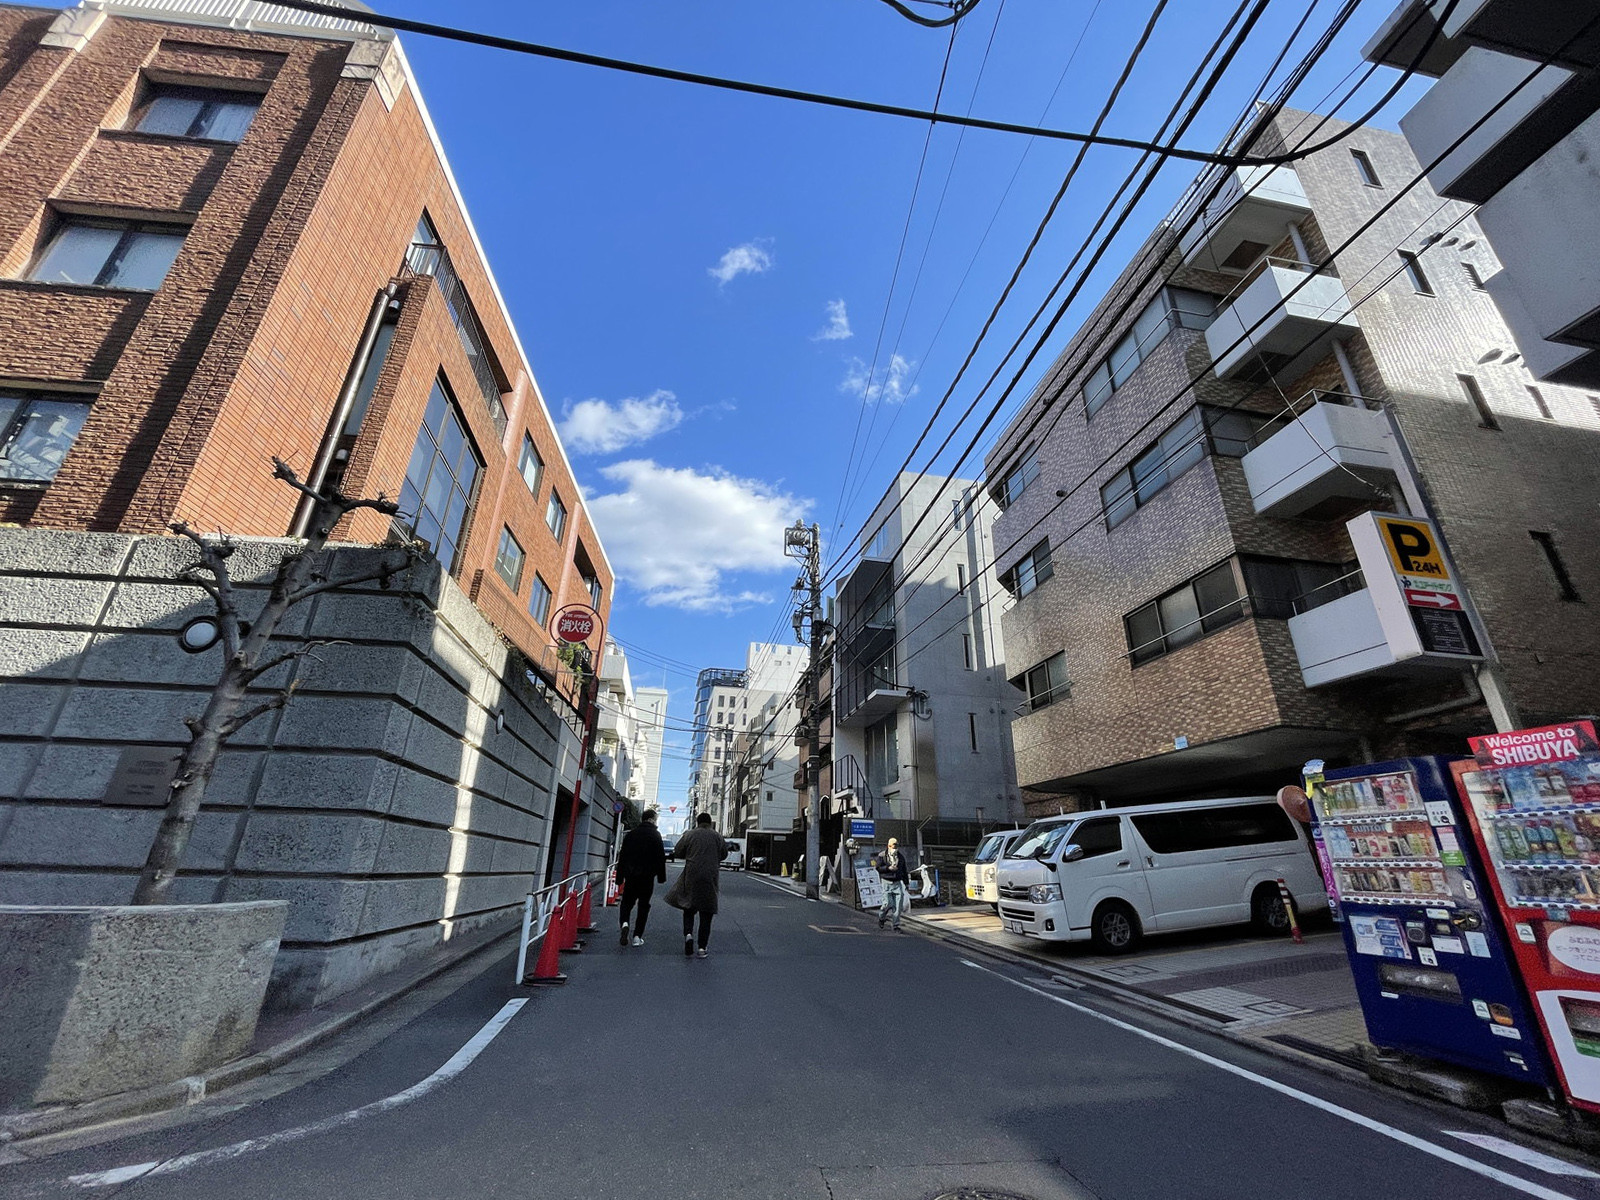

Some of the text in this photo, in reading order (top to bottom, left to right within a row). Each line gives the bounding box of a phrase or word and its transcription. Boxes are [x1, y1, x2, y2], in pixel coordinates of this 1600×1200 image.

[1387, 523, 1430, 571] P
[1412, 560, 1441, 574] 24H
[561, 618, 591, 634] 消火栓
[1485, 727, 1576, 748] Welcome to
[1492, 739, 1580, 765] SHIBUYA
